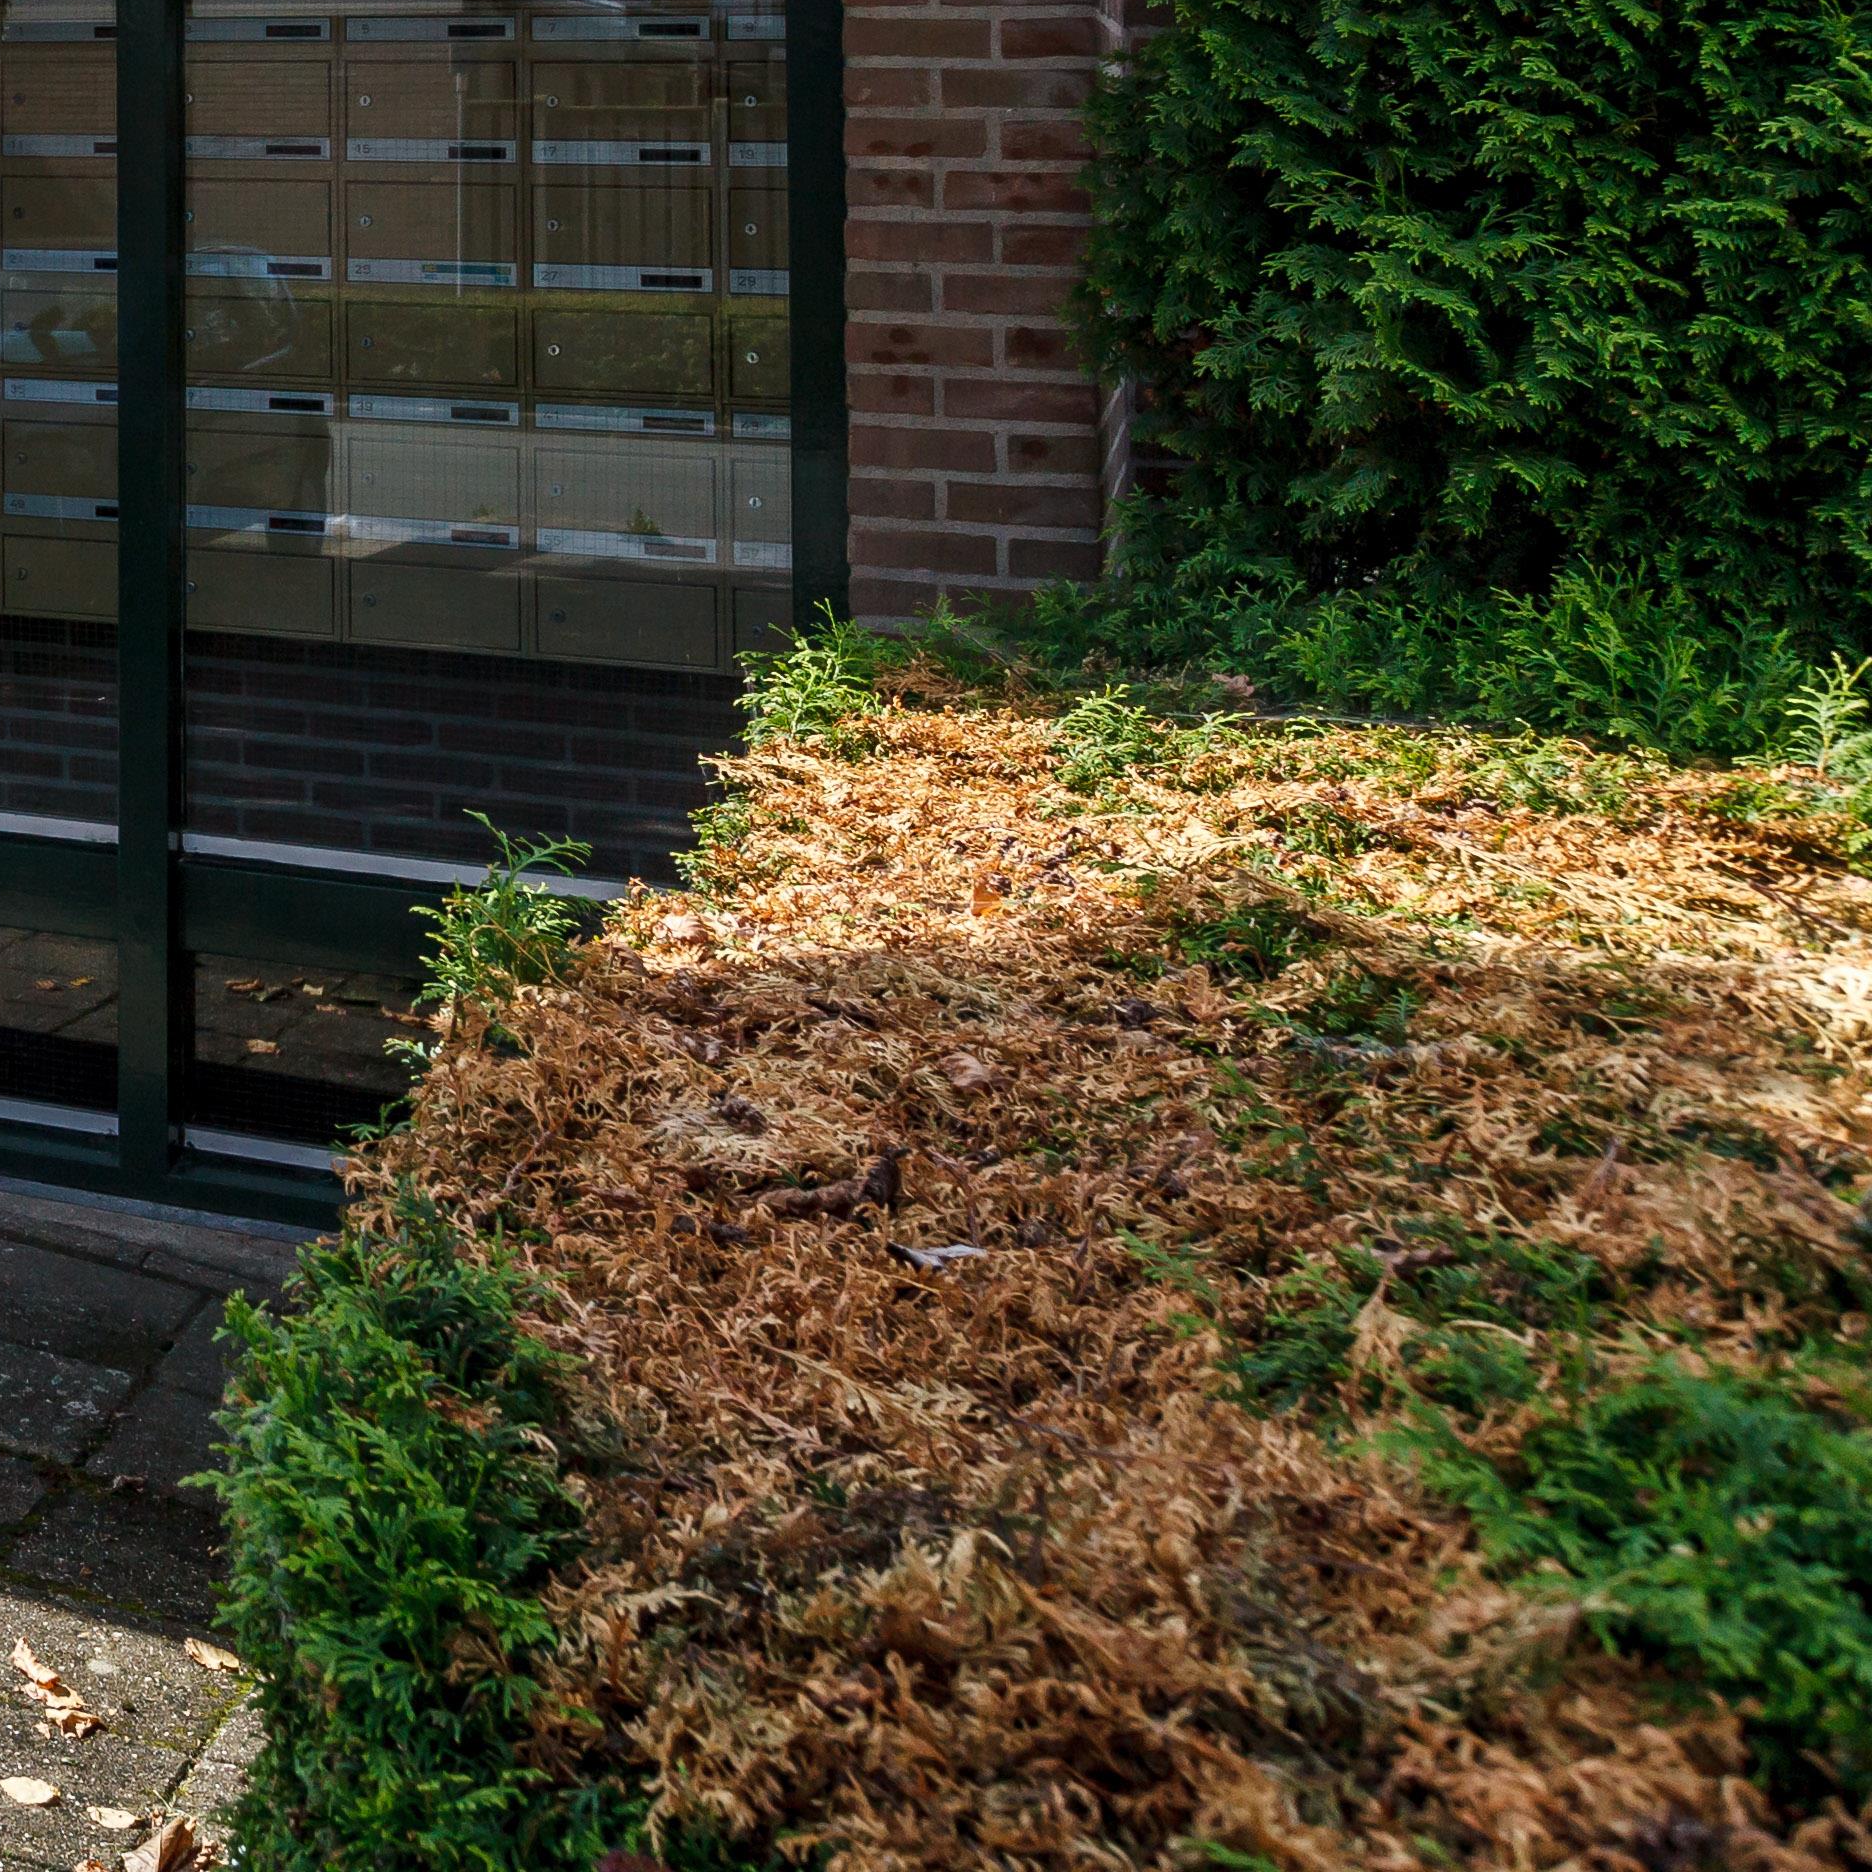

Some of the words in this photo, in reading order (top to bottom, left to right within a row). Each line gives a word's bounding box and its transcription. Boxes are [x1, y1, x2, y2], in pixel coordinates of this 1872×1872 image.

[549, 23, 556, 33] 7
[355, 143, 369, 154] 15
[542, 144, 557, 156] 17
[739, 148, 755, 159] 19
[541, 270, 558, 282] 27
[356, 399, 373, 411] 39
